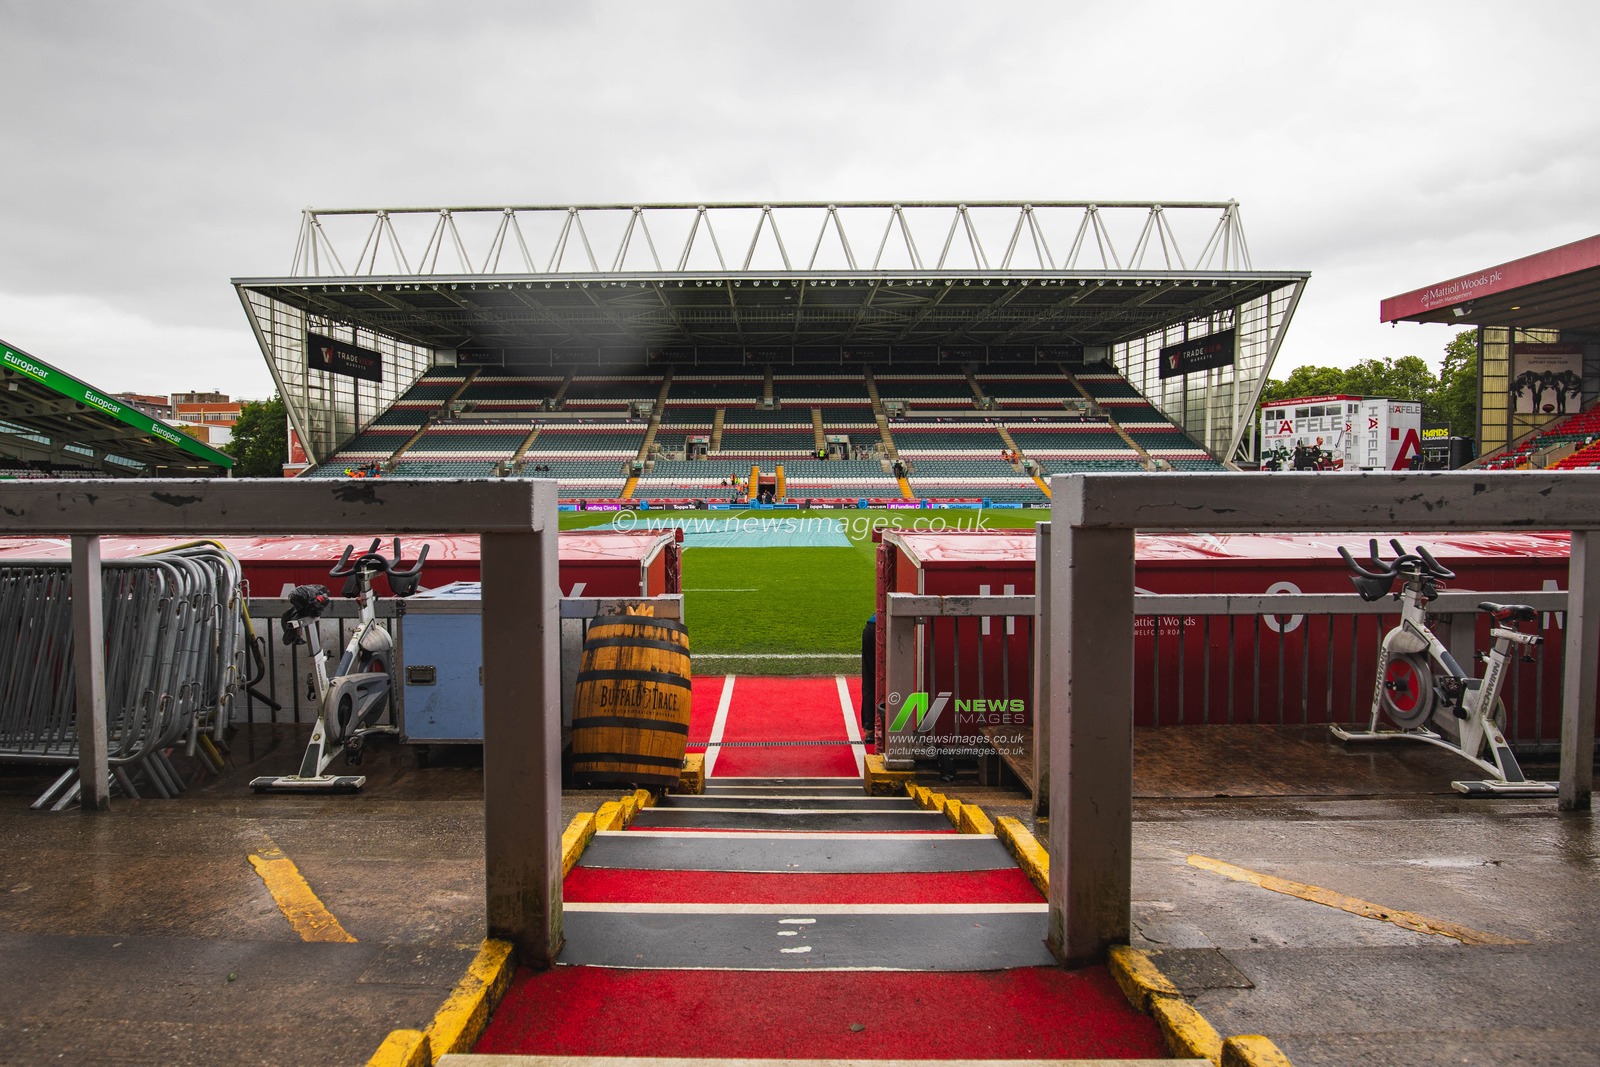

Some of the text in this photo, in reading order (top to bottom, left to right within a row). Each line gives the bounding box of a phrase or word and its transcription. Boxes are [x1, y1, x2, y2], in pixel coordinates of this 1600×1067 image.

[1430, 271, 1502, 299] Mattioli Woods plc
[1445, 291, 1472, 302] Management
[4, 351, 49, 379] Europcar
[85, 391, 121, 414] Europcar
[1389, 405, 1420, 414] HÄFELE
[152, 424, 181, 444] Europcar
[1265, 416, 1343, 434] HÄFELE
[1368, 406, 1378, 466] HÄFELE
[1134, 616, 1196, 627] attioi Wods
[1480, 661, 1500, 715] SCHWINN
